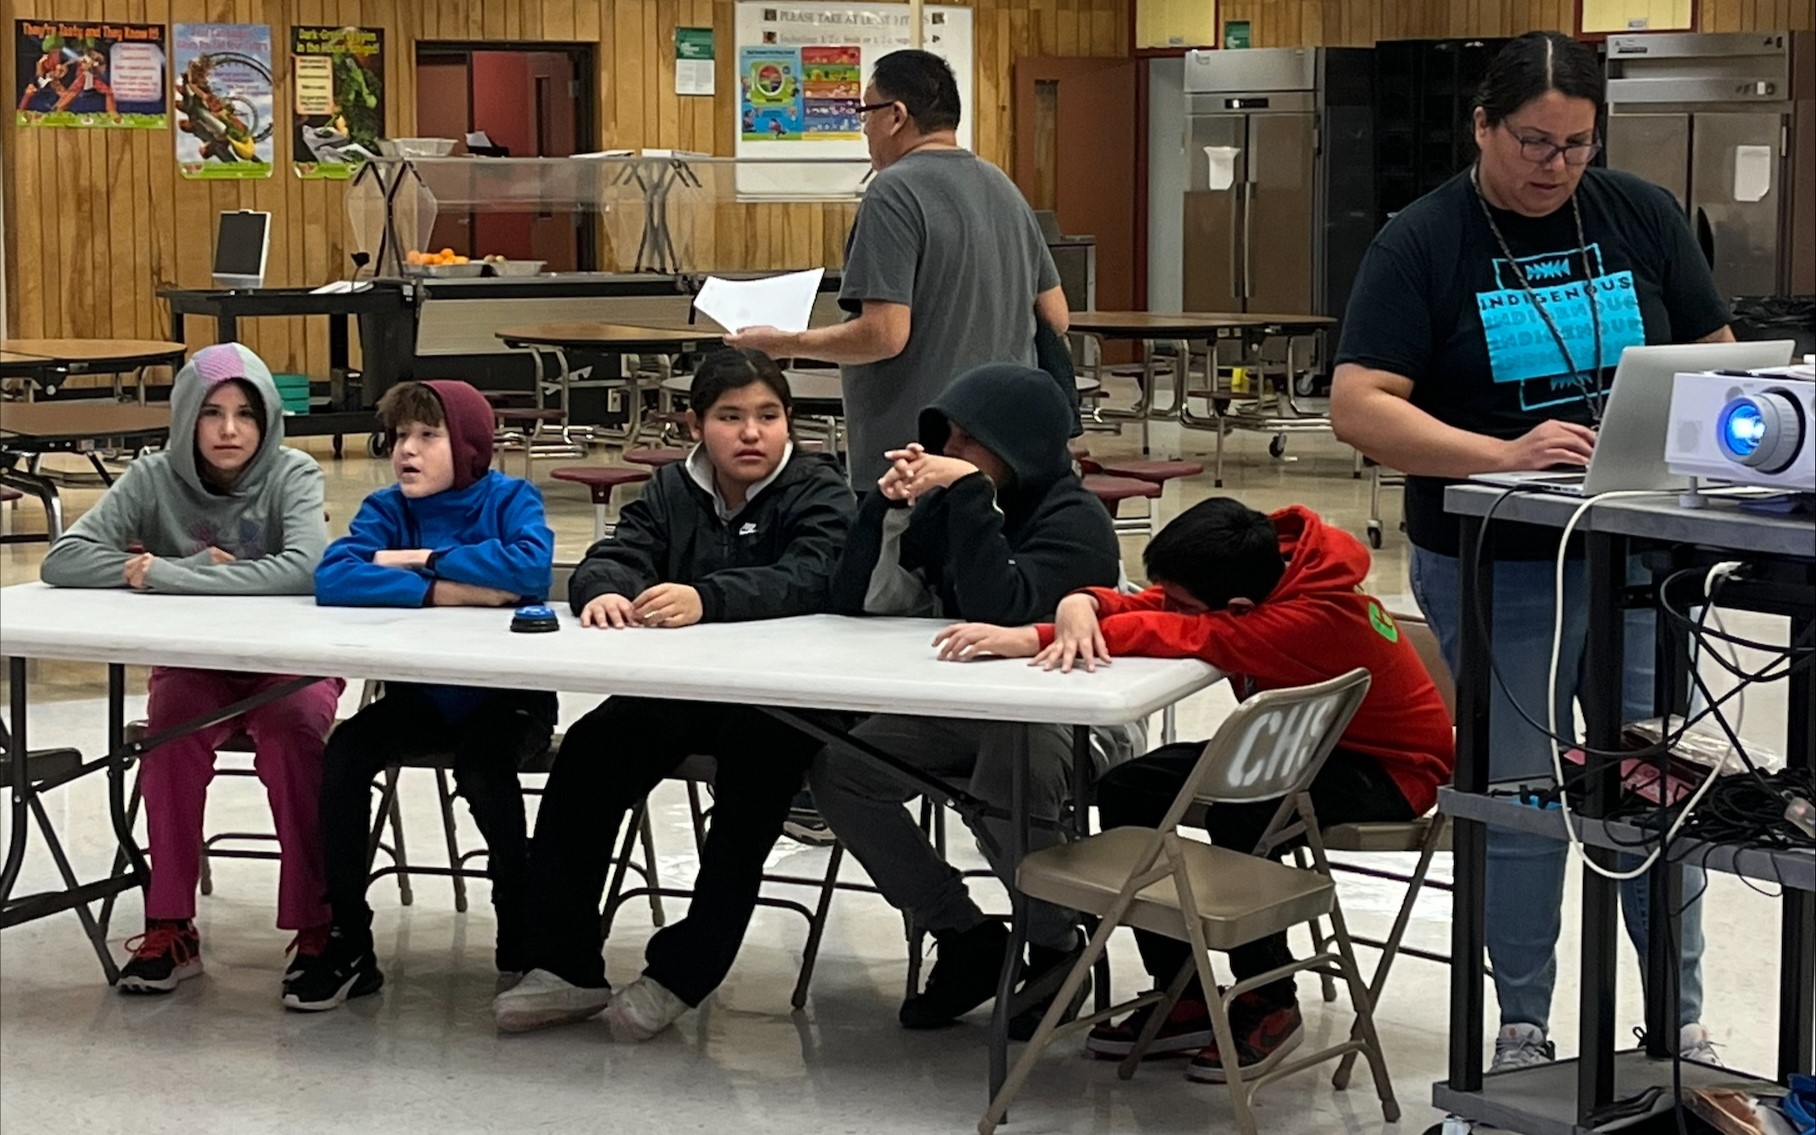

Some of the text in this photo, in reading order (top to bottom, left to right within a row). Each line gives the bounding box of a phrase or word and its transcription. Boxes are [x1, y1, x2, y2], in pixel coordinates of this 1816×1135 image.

[780, 10, 815, 23] PLEASE
[818, 13, 843, 24] TAKE
[1481, 276, 1632, 310] INDIGENOUS
[1485, 294, 1638, 331] INDIENOUS
[1227, 698, 1338, 787] CHS
